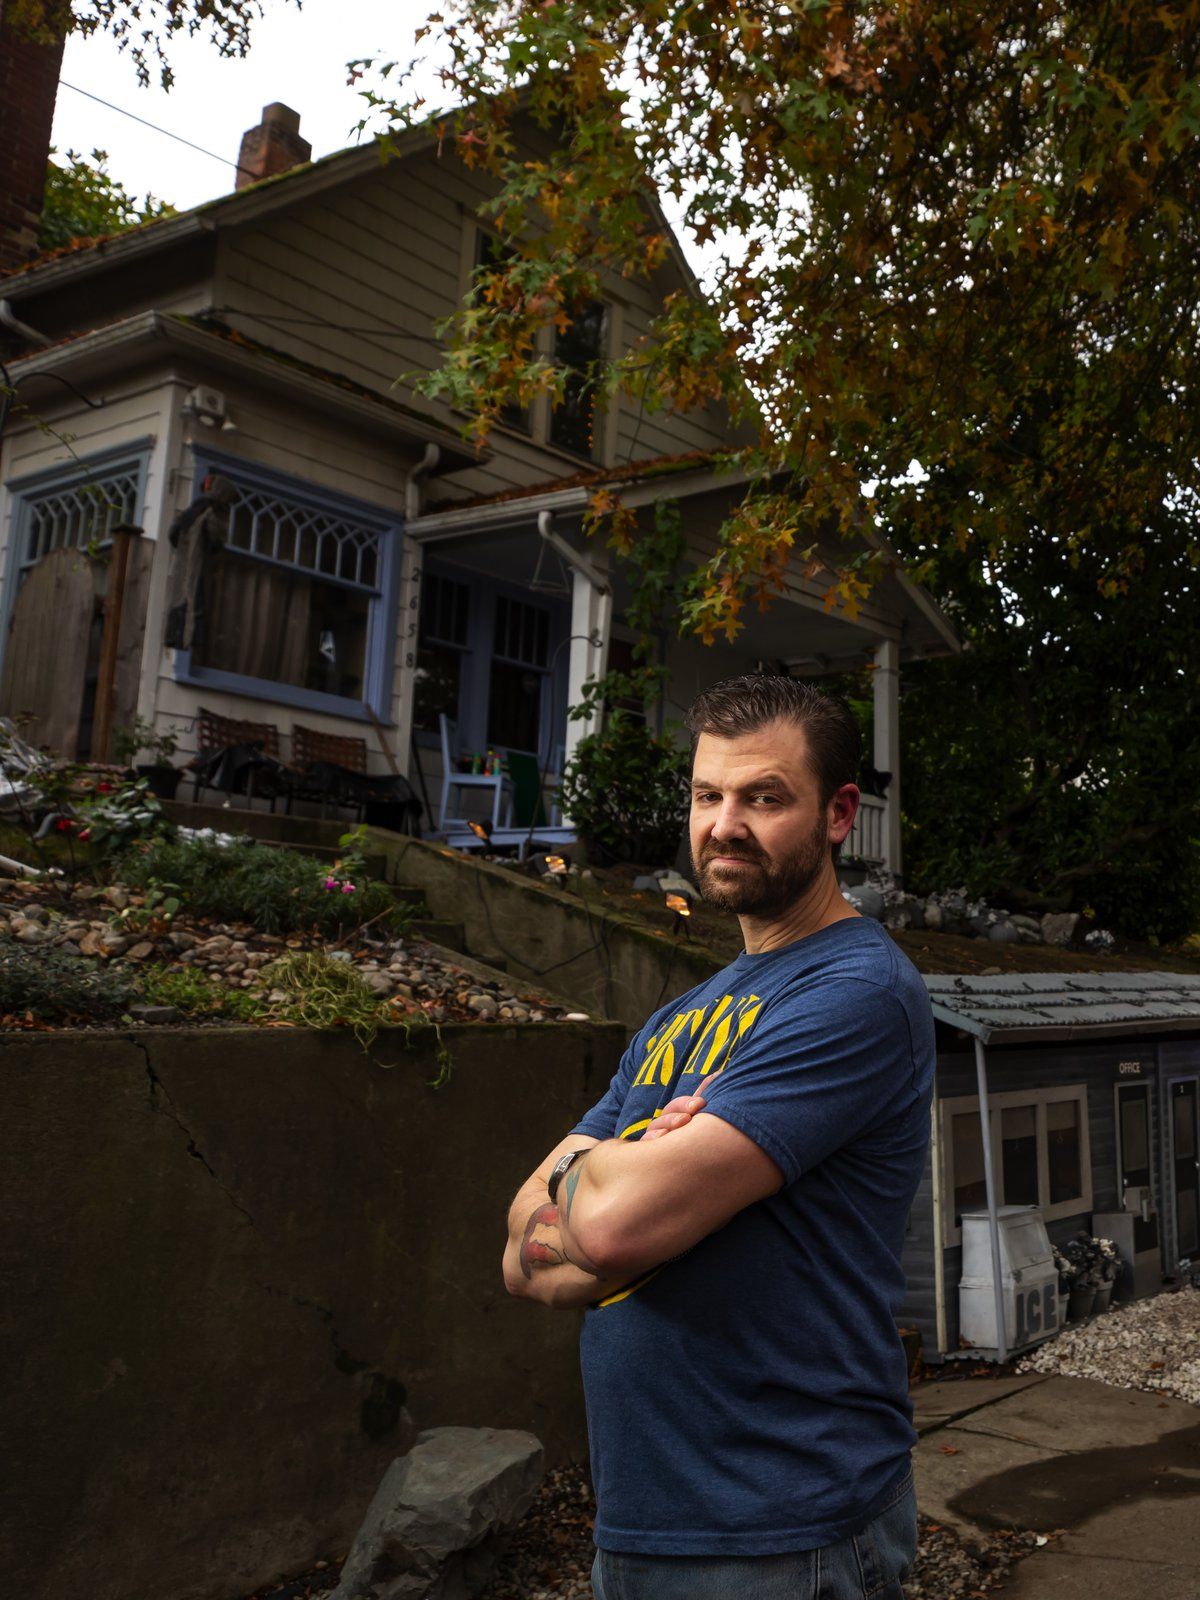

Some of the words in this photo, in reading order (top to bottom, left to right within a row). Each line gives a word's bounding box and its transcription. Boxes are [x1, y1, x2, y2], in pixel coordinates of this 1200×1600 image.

[405, 566, 420, 668] 2658
[1118, 1062, 1141, 1074] OFFICE
[1016, 1283, 1058, 1339] ICE
